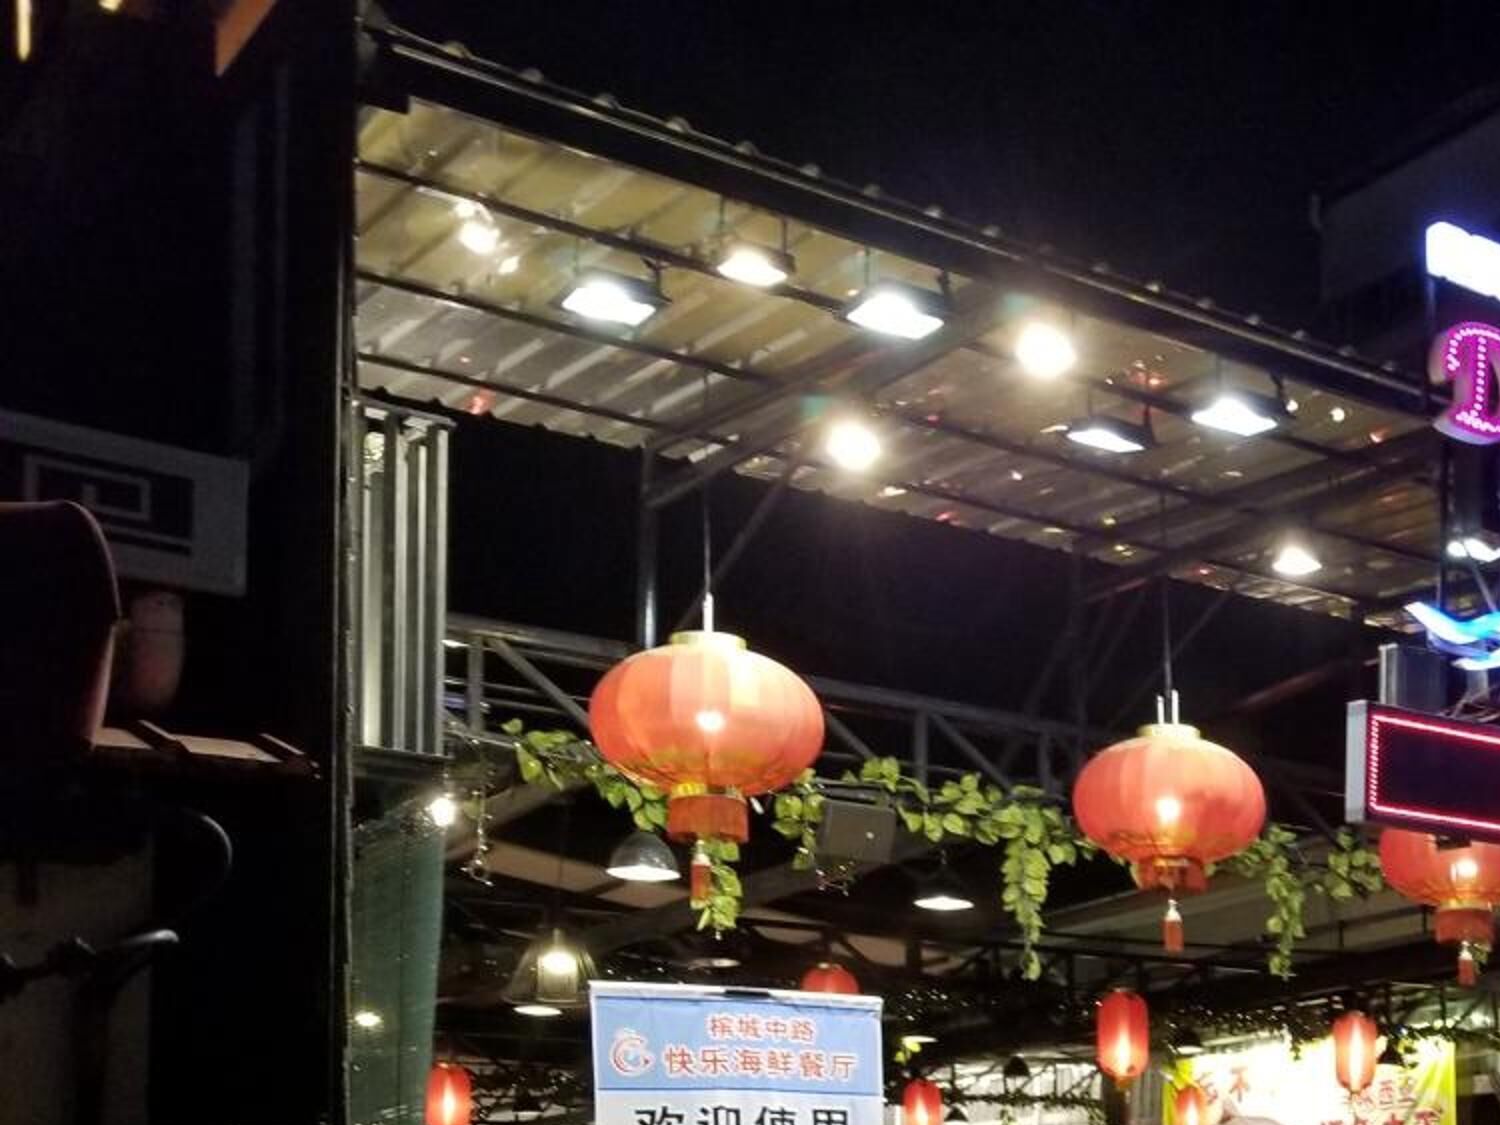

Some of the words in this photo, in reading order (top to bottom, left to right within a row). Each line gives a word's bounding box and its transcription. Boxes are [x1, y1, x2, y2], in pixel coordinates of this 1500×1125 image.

[664, 1046, 858, 1080] 快乐海鲜餐厅
